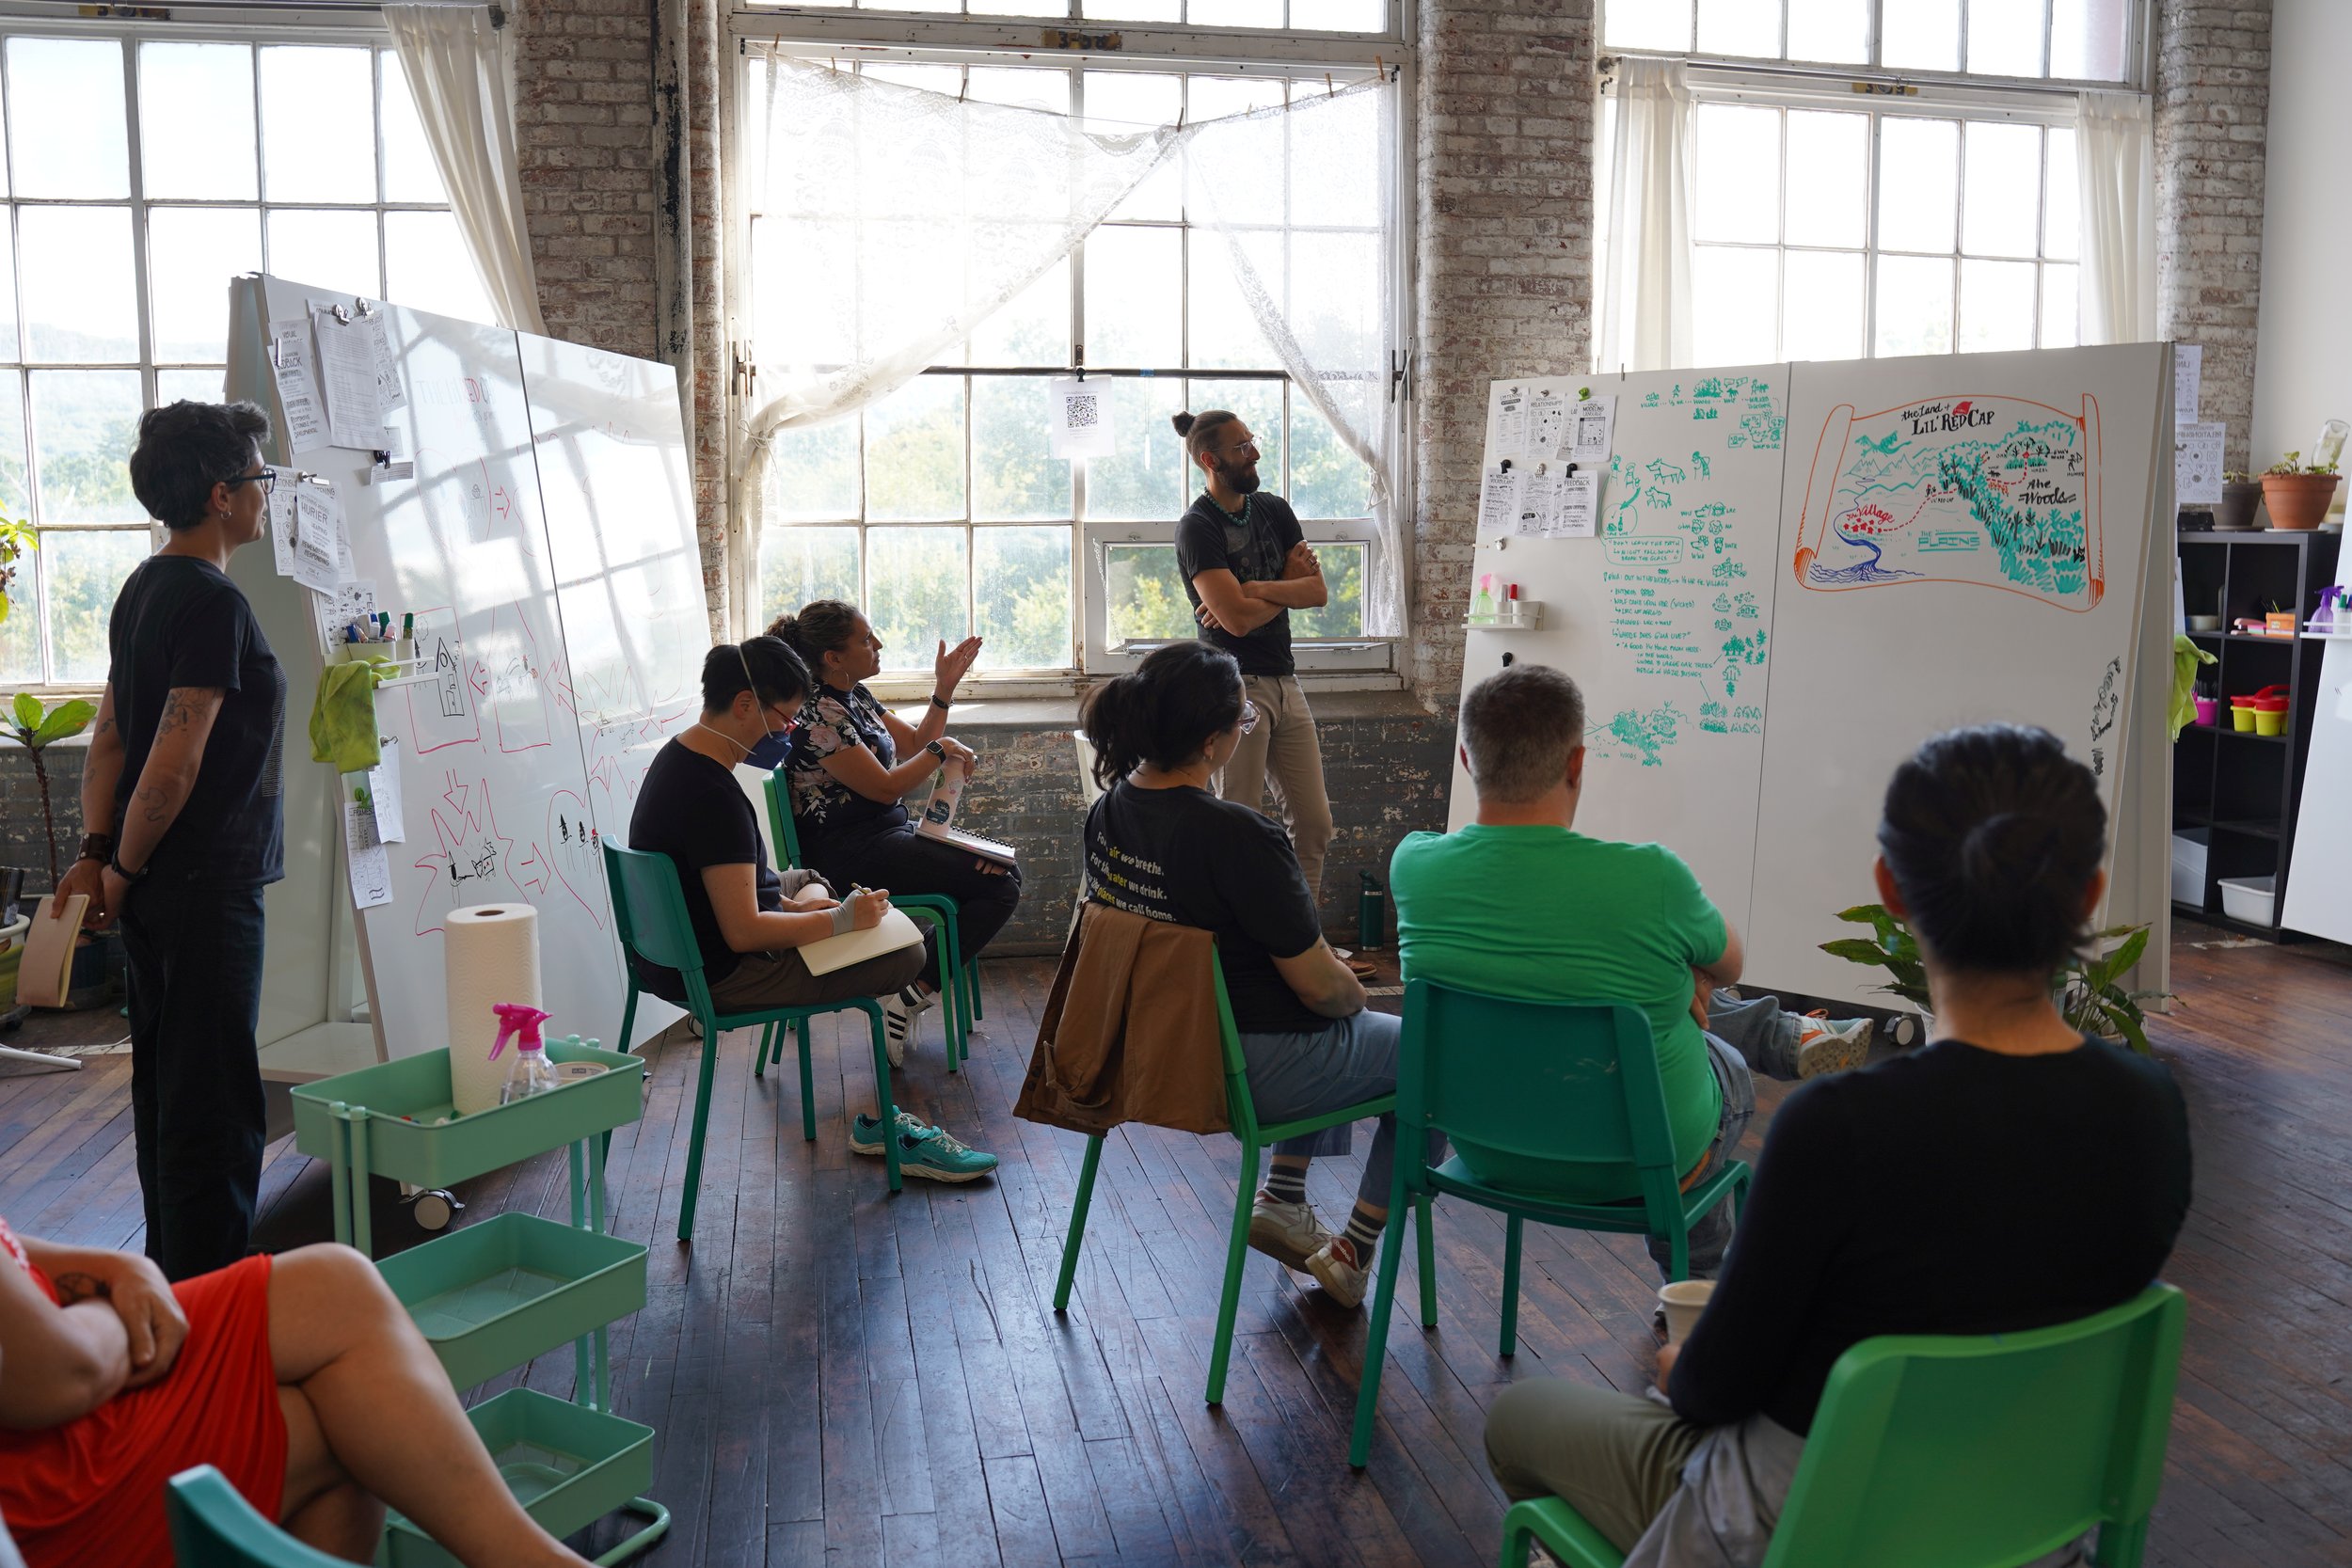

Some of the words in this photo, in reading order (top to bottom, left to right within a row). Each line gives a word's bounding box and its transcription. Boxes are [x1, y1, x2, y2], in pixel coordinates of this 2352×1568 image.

[1967, 408, 1995, 427] CAP
[301, 501, 328, 525] HURIER
[1857, 503, 1896, 525] Village
[1918, 536, 1980, 547] PLAINS
[1109, 845, 1120, 859] air
[1120, 853, 1135, 864] we
[1090, 851, 1102, 867] For
[1128, 880, 1139, 894] we
[1139, 883, 1168, 900] drink.
[1096, 886, 1116, 904] places
[1116, 898, 1128, 911] we
[1128, 902, 1145, 916] call
[1145, 906, 1177, 923] home.
